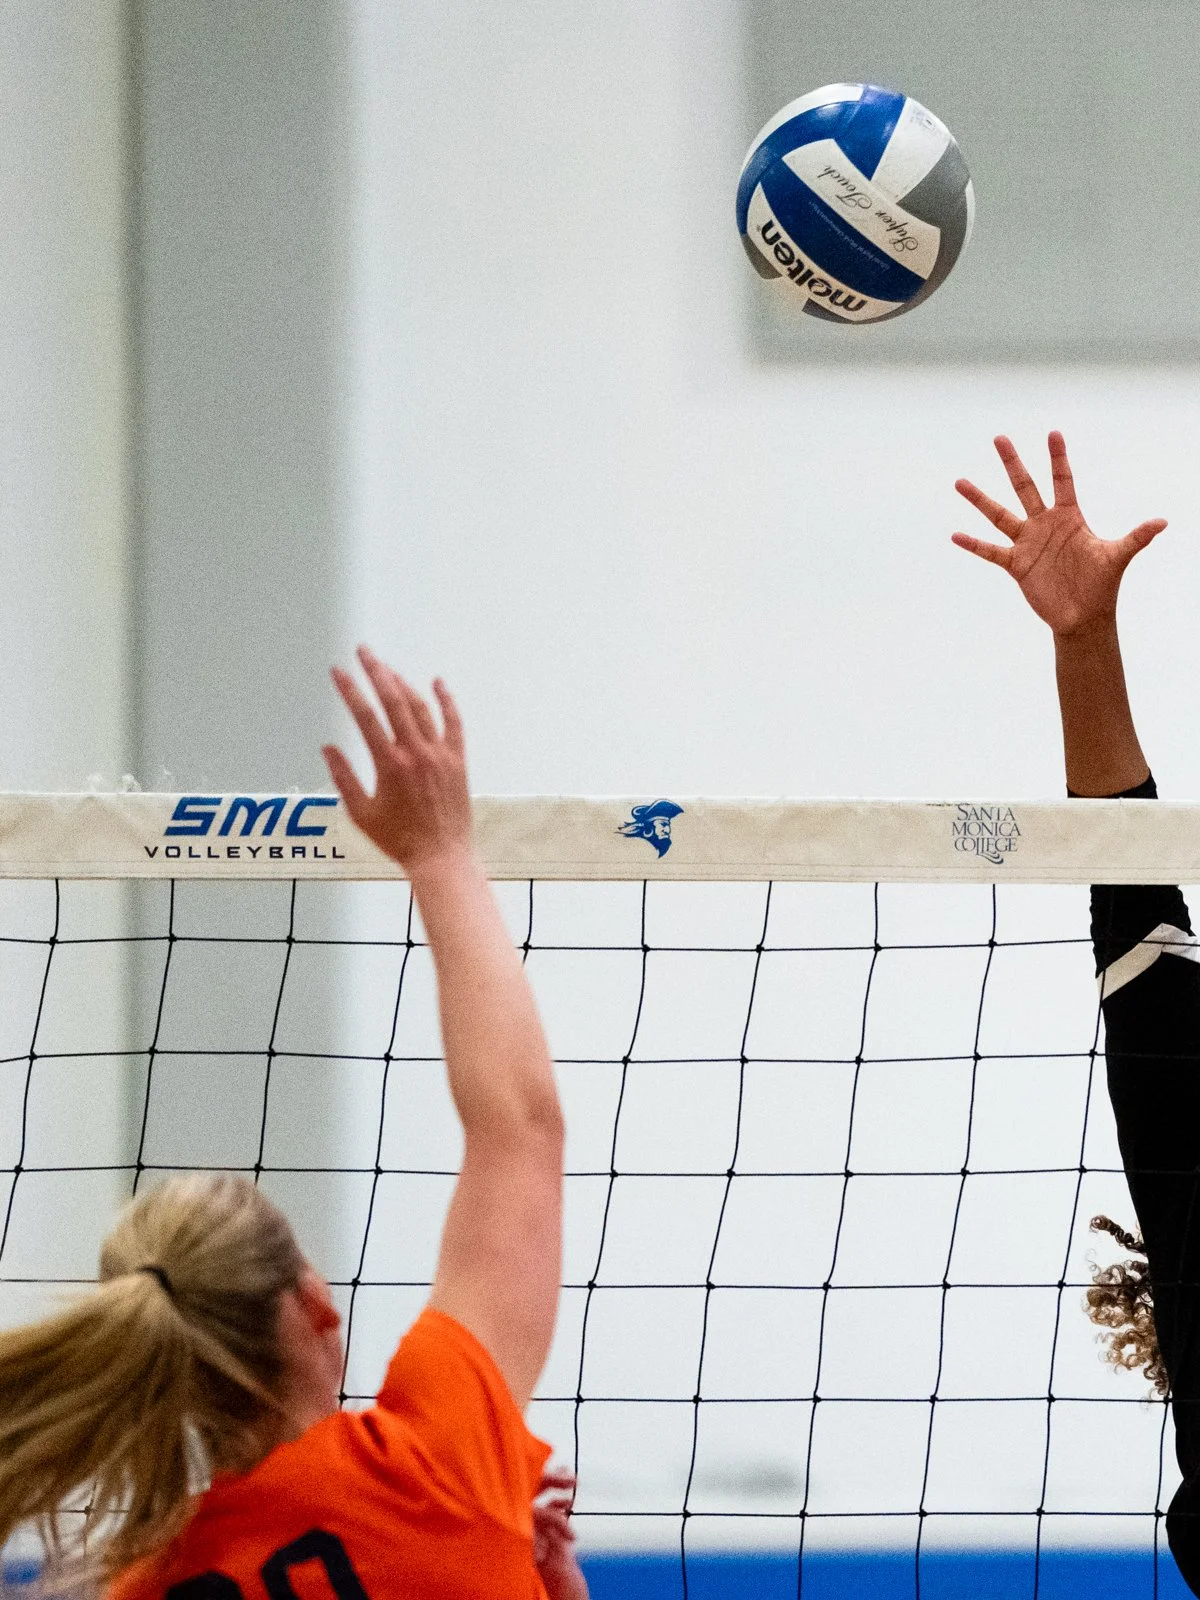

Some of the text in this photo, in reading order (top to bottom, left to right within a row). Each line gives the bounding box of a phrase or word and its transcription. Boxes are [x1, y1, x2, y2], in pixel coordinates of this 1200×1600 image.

[816, 164, 873, 210] Touch
[760, 219, 868, 312] molten
[164, 796, 340, 836] SMC
[956, 804, 1016, 821] SANTA
[951, 821, 1021, 836] MONICA
[144, 845, 346, 859] VOLLEYBALL
[954, 836, 1018, 865] COLLEGE
